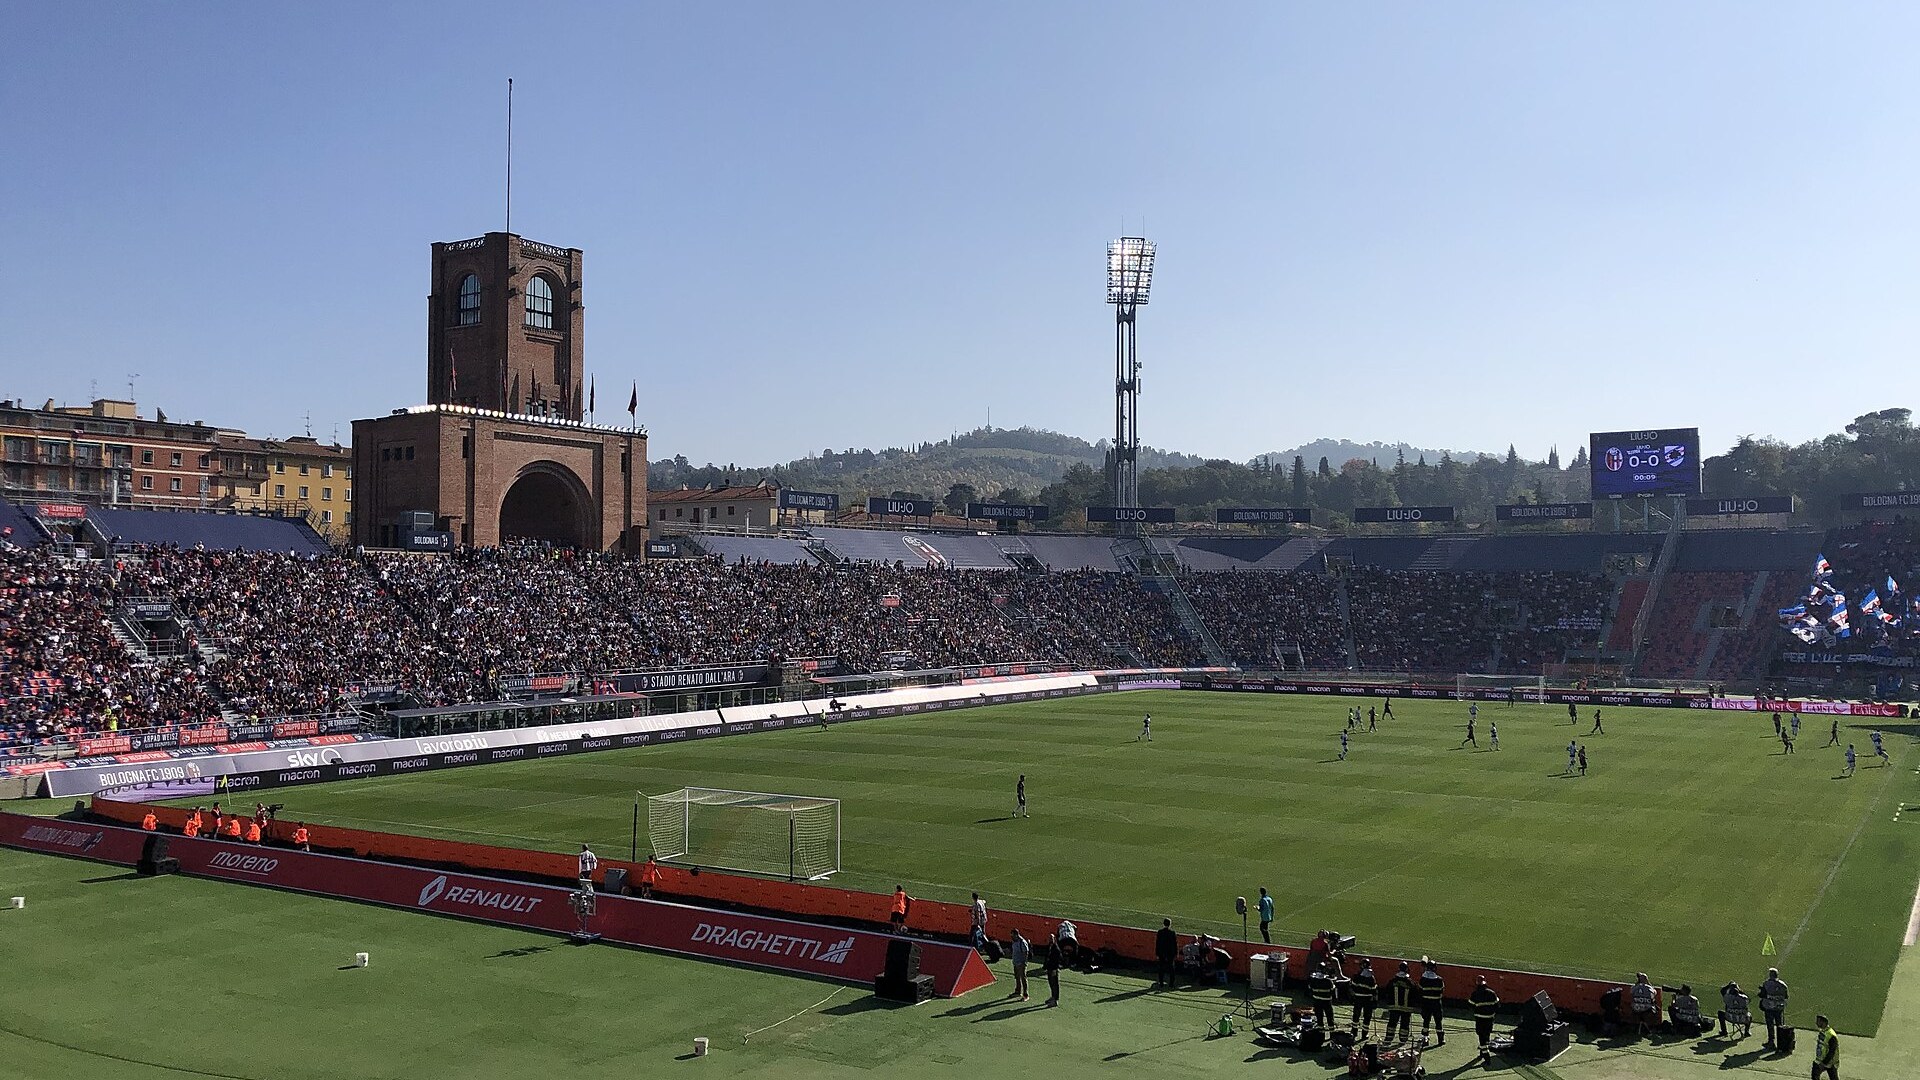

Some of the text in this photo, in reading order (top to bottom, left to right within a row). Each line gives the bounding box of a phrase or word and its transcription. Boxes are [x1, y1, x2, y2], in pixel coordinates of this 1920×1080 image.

[1863, 495, 1897, 506] BOLOGNA
[1899, 494, 1908, 505] FC
[651, 670, 736, 688] STADIO RENATO DALL'ARA
[731, 722, 754, 732] macron
[763, 720, 784, 728] macron
[661, 730, 686, 740] macron
[697, 726, 720, 735] macron
[144, 732, 178, 743] ARPAD WEISZ
[582, 738, 610, 748] macron
[623, 734, 650, 744] macron
[492, 748, 524, 758] macron
[538, 743, 568, 754] macron
[288, 750, 318, 767] sky
[393, 758, 429, 770] macron
[444, 752, 478, 764] macron
[100, 770, 145, 786] BOLOGNA
[146, 770, 159, 782] FC
[161, 766, 184, 780] 1909
[280, 769, 320, 782] macron
[338, 764, 376, 776] macron
[209, 851, 279, 872] moreno
[444, 886, 543, 912] RENAULT
[690, 924, 822, 960] DRAGHETTI
